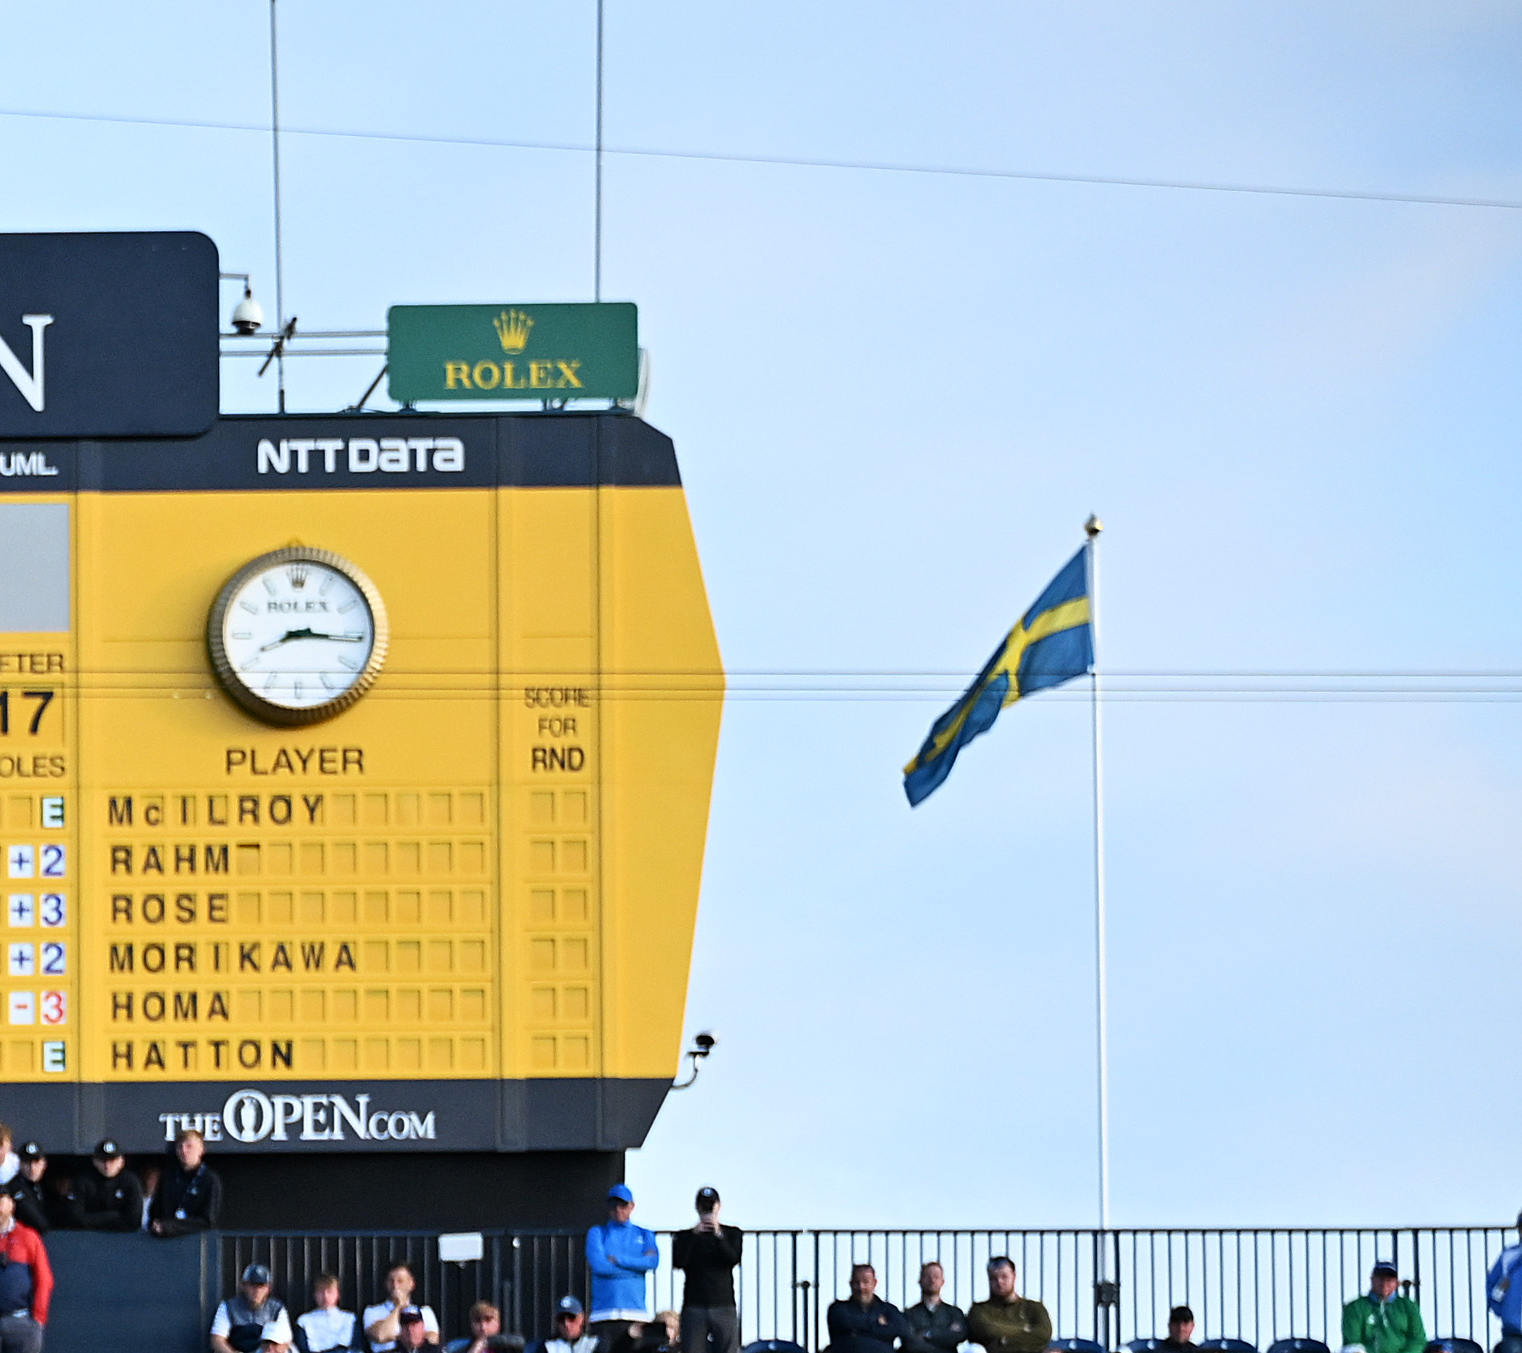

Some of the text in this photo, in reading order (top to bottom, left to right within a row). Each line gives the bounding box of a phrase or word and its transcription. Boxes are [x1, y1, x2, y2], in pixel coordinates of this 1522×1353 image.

[444, 360, 585, 391] ROLEX
[257, 437, 345, 473] NTT
[267, 600, 329, 613] ROLEX
[525, 688, 590, 709] SCORE
[538, 717, 577, 736] FOR
[226, 747, 364, 775] PLAYER
[532, 747, 585, 771] RND
[41, 796, 65, 828] E
[111, 844, 230, 875] RAHM
[111, 893, 229, 924] ROSE
[109, 942, 357, 973] MORIKAWA
[112, 991, 230, 1022] HOMA
[42, 1040, 294, 1072] E HATTON
